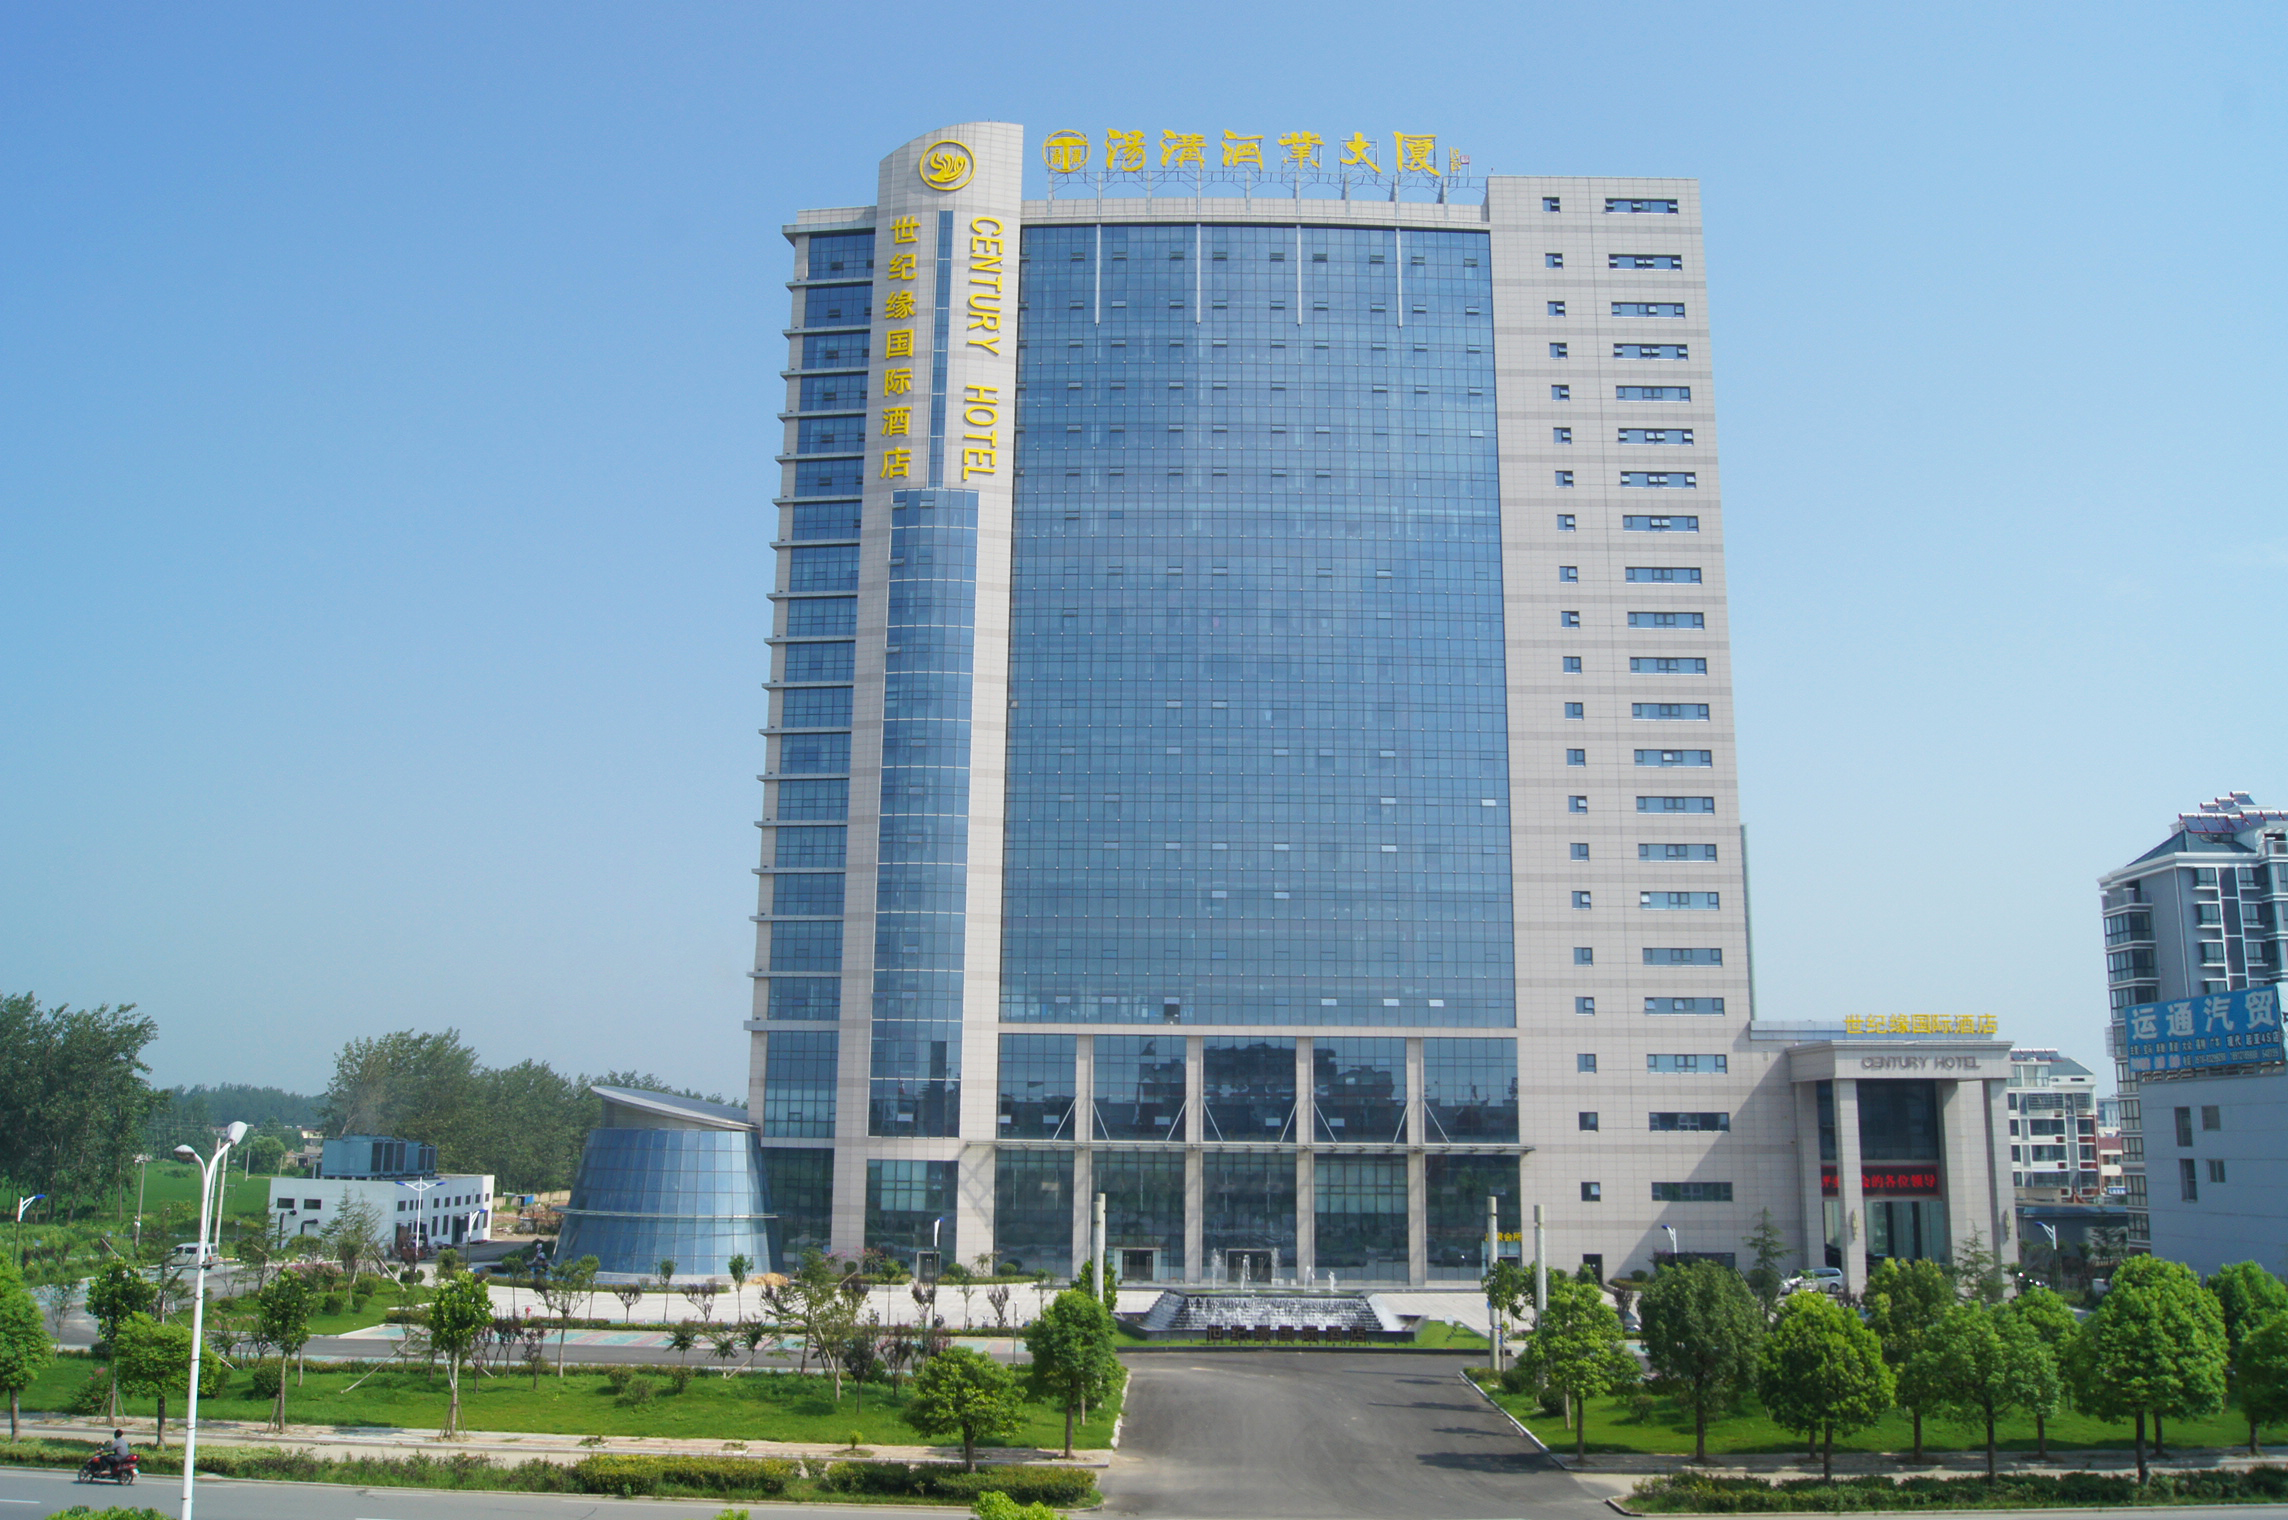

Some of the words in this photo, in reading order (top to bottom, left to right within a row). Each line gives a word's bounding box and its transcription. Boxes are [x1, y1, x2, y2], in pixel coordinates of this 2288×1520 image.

[968, 216, 1005, 356] CENTURY
[880, 215, 921, 479] 世纪缘国际酒店
[963, 384, 999, 480] HOTEL
[1843, 1013, 1998, 1034] 世纪缘国际酒店
[2131, 990, 2276, 1040] 运通汽贸
[1861, 1056, 1928, 1070] CENTURY
[1934, 1056, 1981, 1070] HOTEL
[1207, 1325, 1367, 1342] 世纪缘国际酒店
